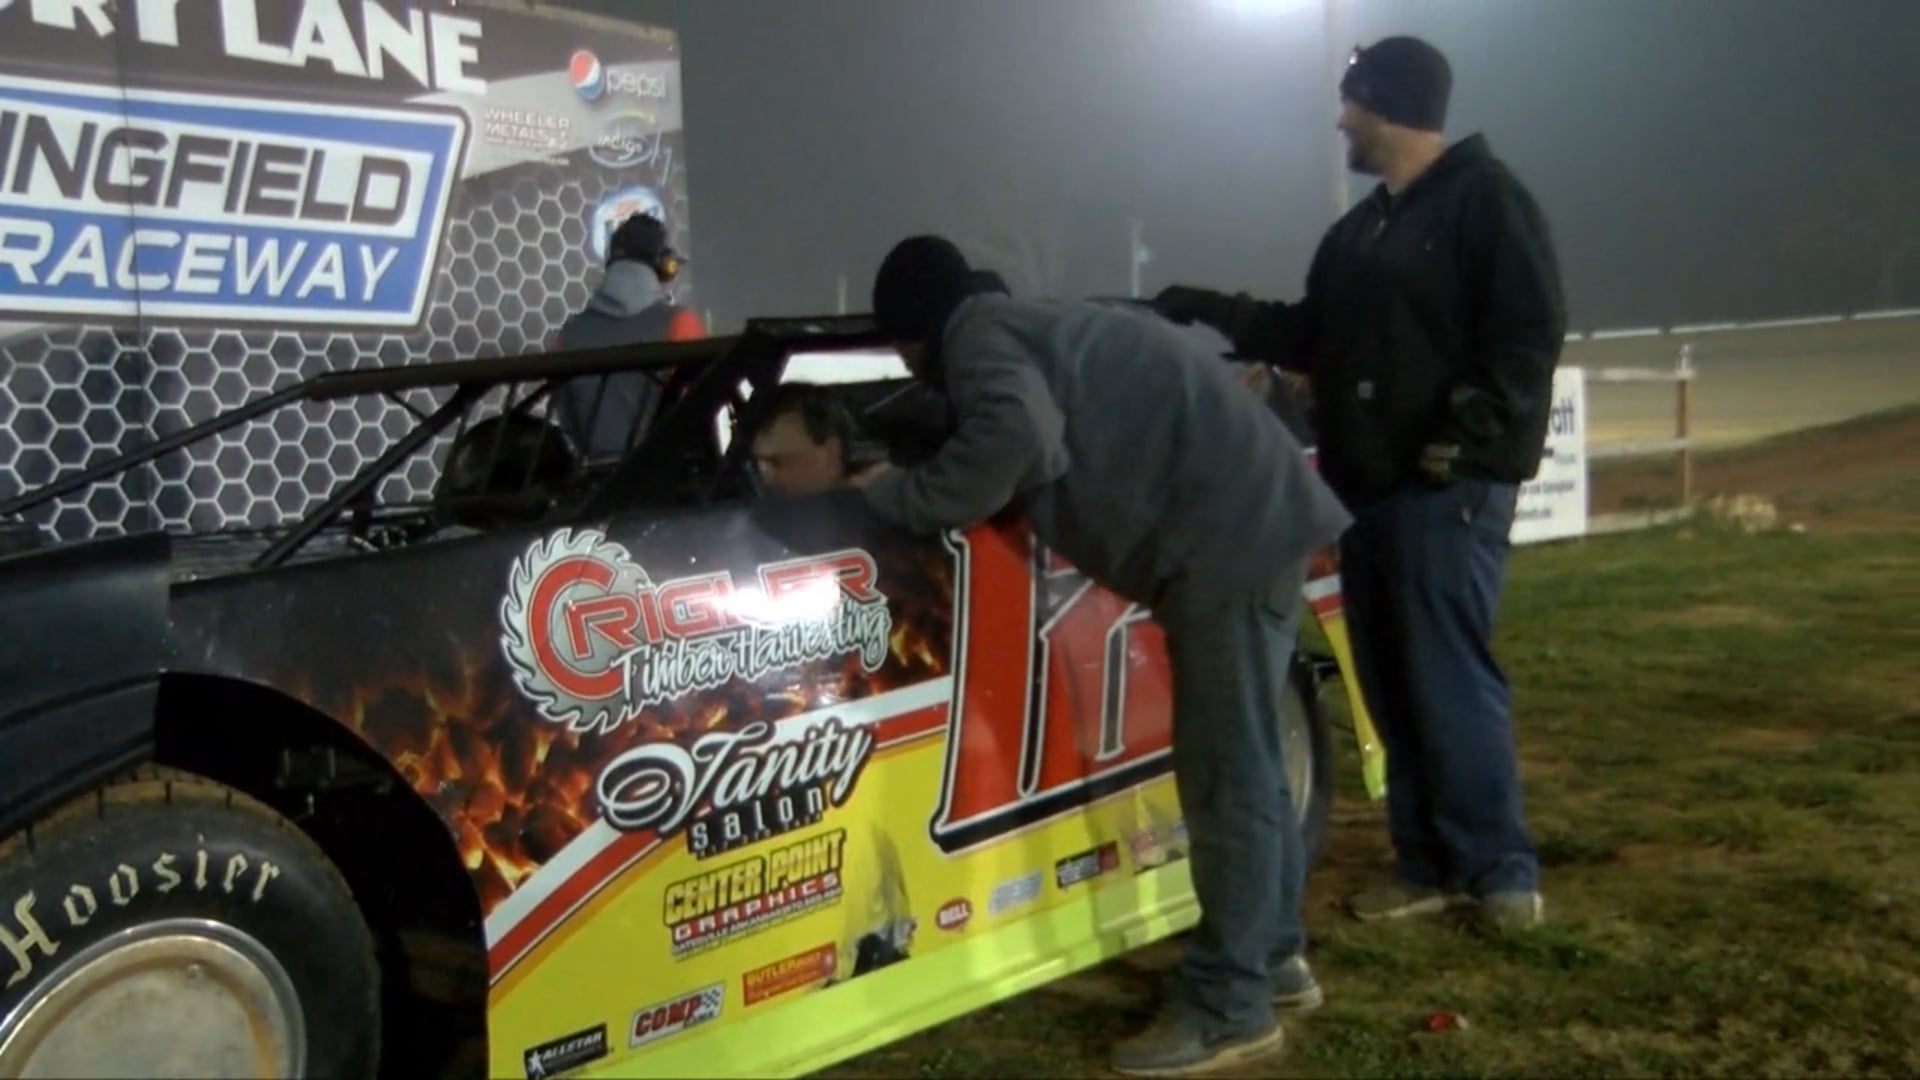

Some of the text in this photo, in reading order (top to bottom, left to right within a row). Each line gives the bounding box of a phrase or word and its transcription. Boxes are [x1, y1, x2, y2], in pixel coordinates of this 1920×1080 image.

[221, 0, 487, 95] LANE
[606, 69, 666, 98] pepsi
[486, 108, 569, 130] WHEELER
[486, 122, 549, 143] METALS
[0, 218, 399, 301] RACEWAY
[609, 600, 890, 702] Timber Harvesting
[599, 722, 868, 833] Vanity
[692, 787, 824, 851] salon
[0, 835, 281, 988] Hoosier
[665, 856, 764, 926] CENTER
[770, 830, 843, 891] POINT
[674, 871, 838, 941] GRAPHICS
[542, 1031, 604, 1062] ALLSTAR
[635, 994, 701, 1037] COMP
